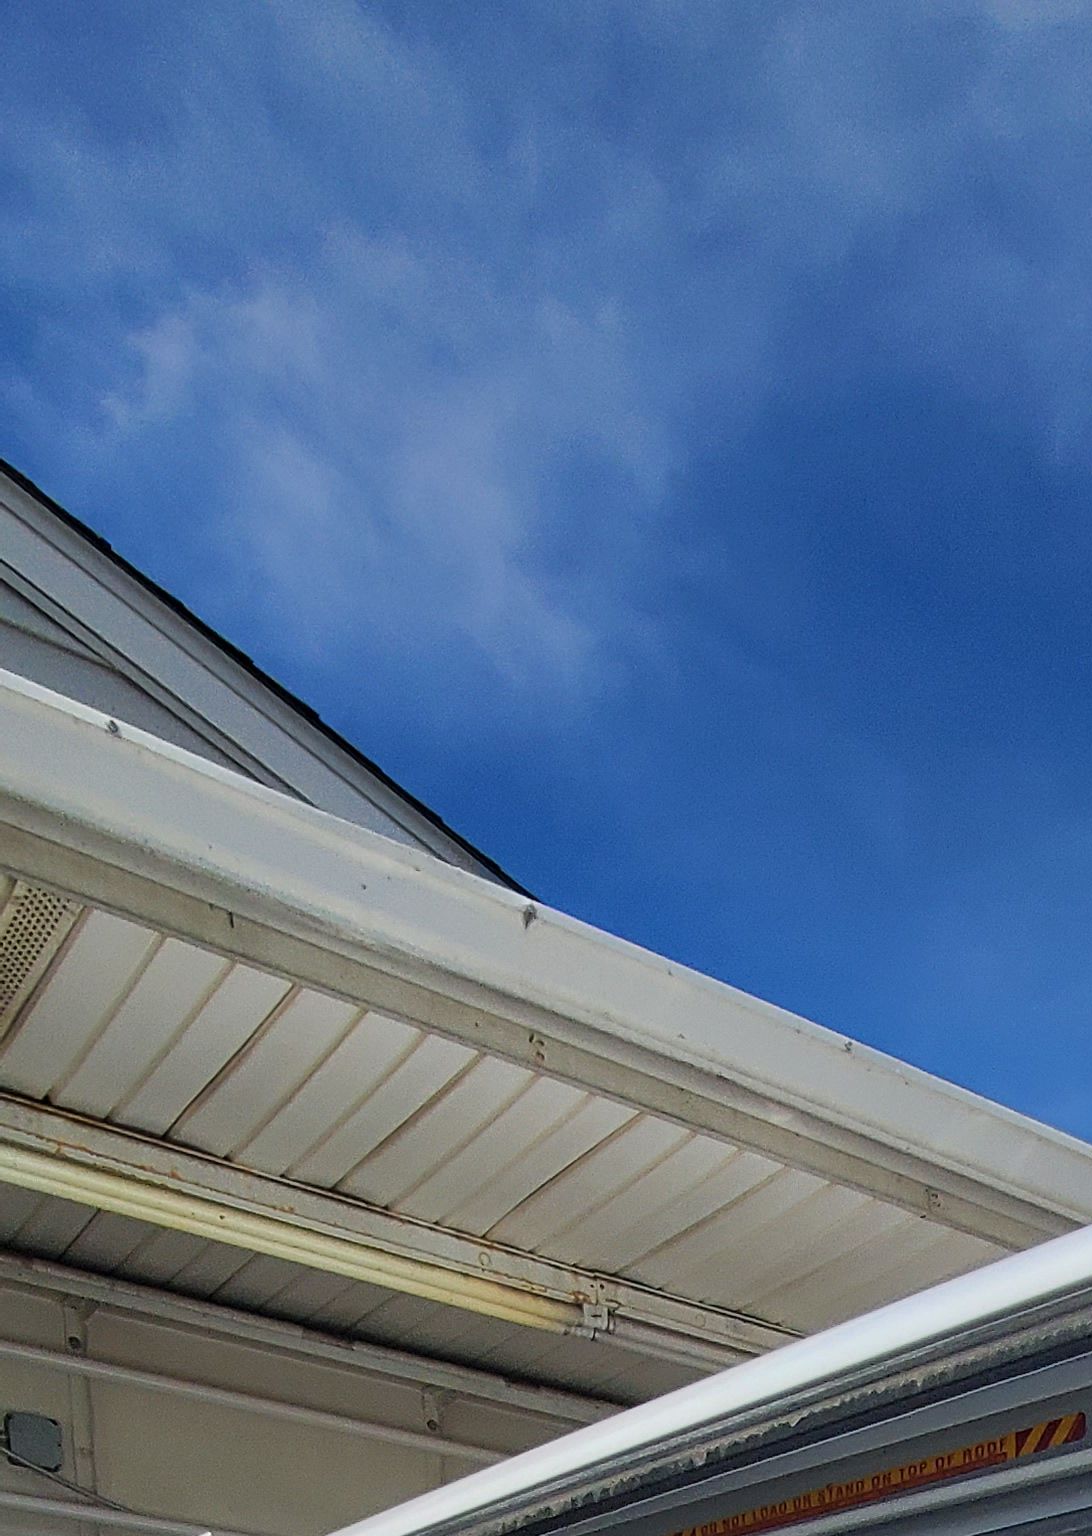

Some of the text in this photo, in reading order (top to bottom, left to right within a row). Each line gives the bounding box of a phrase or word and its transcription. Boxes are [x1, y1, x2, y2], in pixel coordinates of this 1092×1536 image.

[722, 1513, 746, 1530] NOT
[752, 1503, 787, 1522] LOAD
[817, 1480, 865, 1505] STAND
[871, 1471, 892, 1488] ON
[898, 1461, 927, 1480] TOP
[935, 1455, 952, 1471] OF
[962, 1438, 1008, 1463] ROOF
